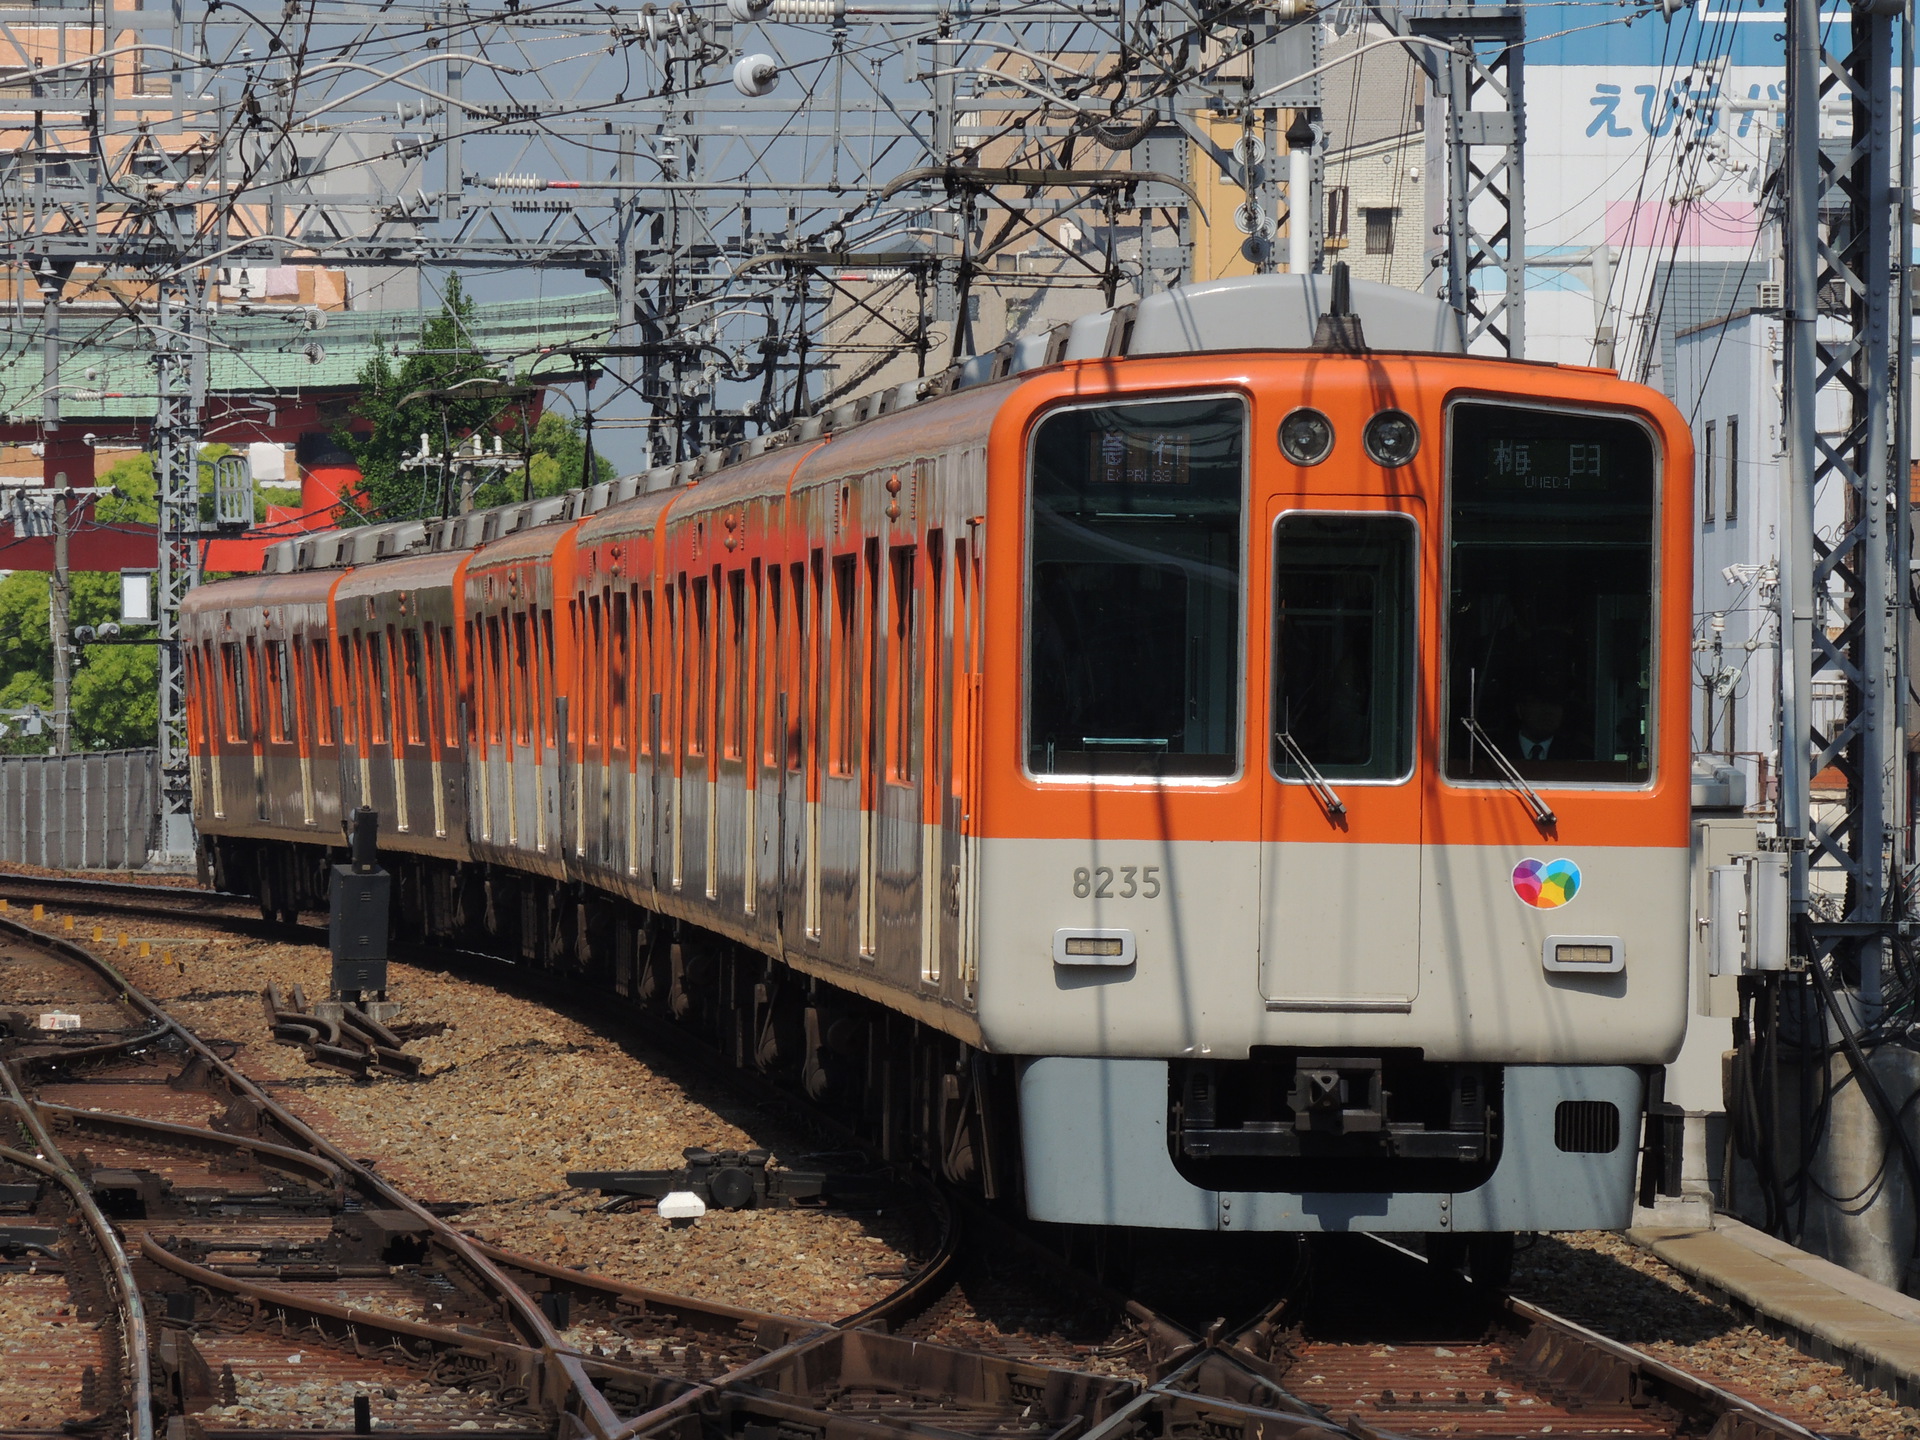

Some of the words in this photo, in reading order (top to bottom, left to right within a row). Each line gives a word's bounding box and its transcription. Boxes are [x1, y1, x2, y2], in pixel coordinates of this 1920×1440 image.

[1101, 433, 1186, 466] 急行
[1493, 439, 1601, 477] 梅田
[1073, 866, 1161, 899] 8235
